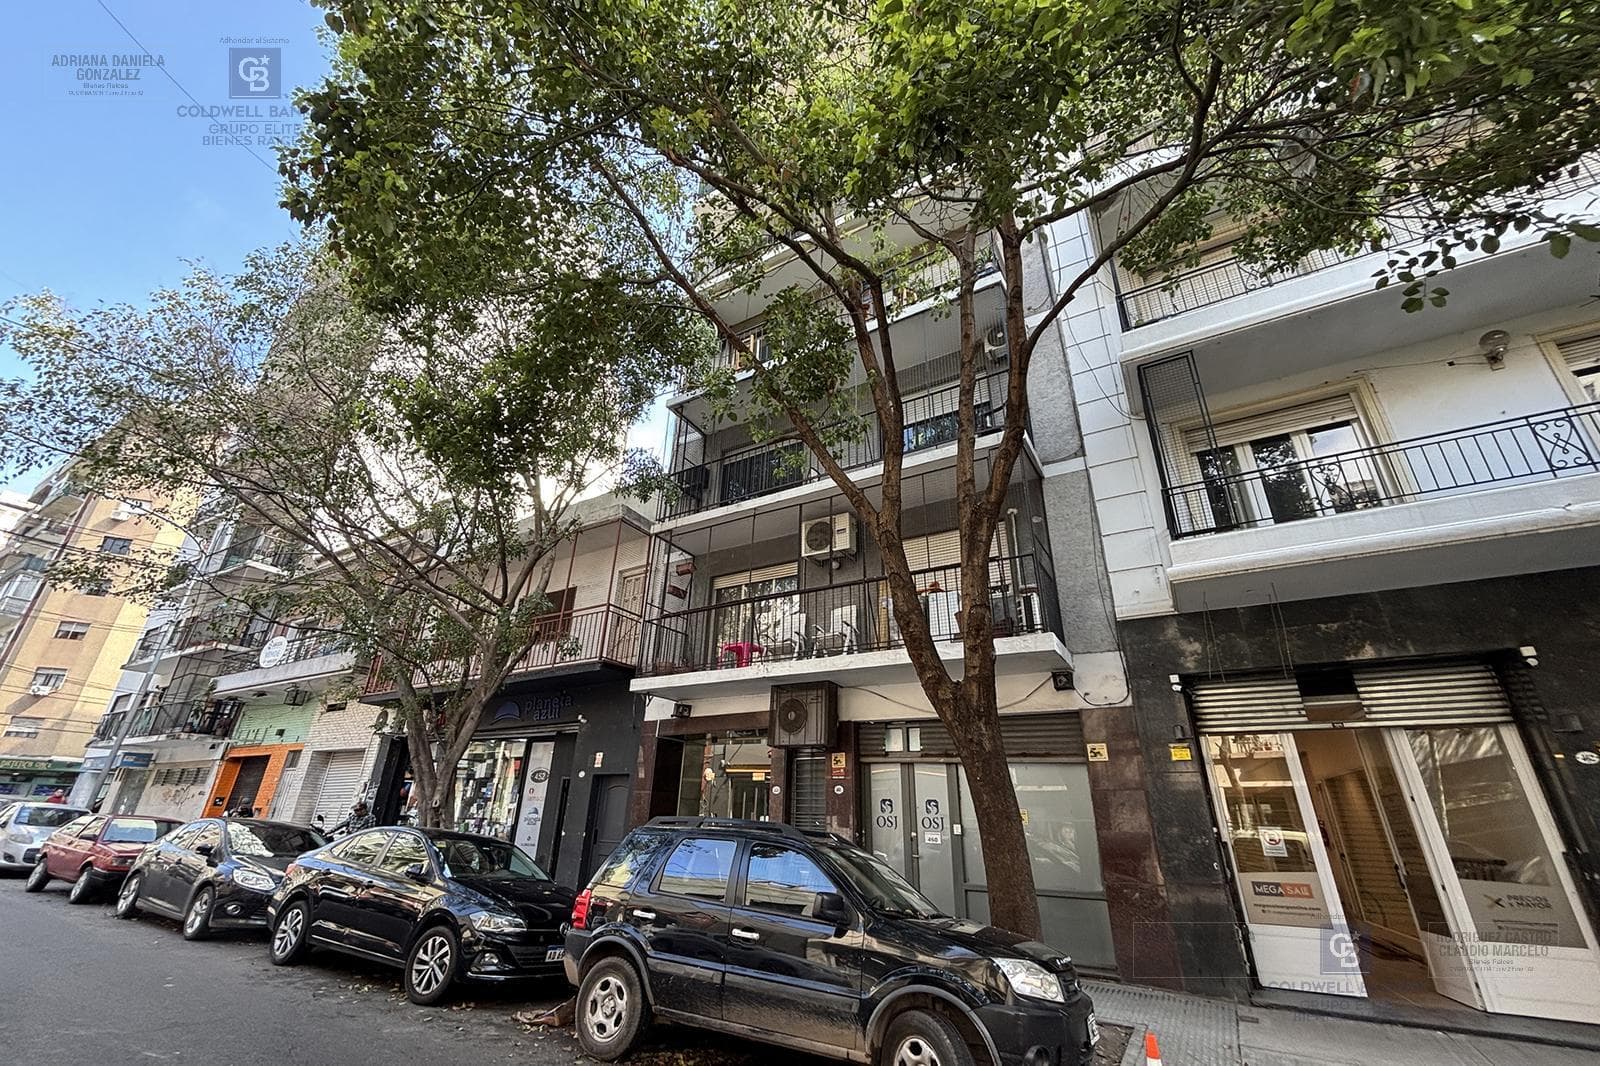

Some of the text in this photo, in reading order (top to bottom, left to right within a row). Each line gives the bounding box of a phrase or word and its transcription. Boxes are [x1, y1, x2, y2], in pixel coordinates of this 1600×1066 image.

[533, 707, 560, 721] azul
[876, 815, 899, 831] OSJ
[921, 816, 945, 832] OSJ
[1254, 884, 1285, 895] MEGA
